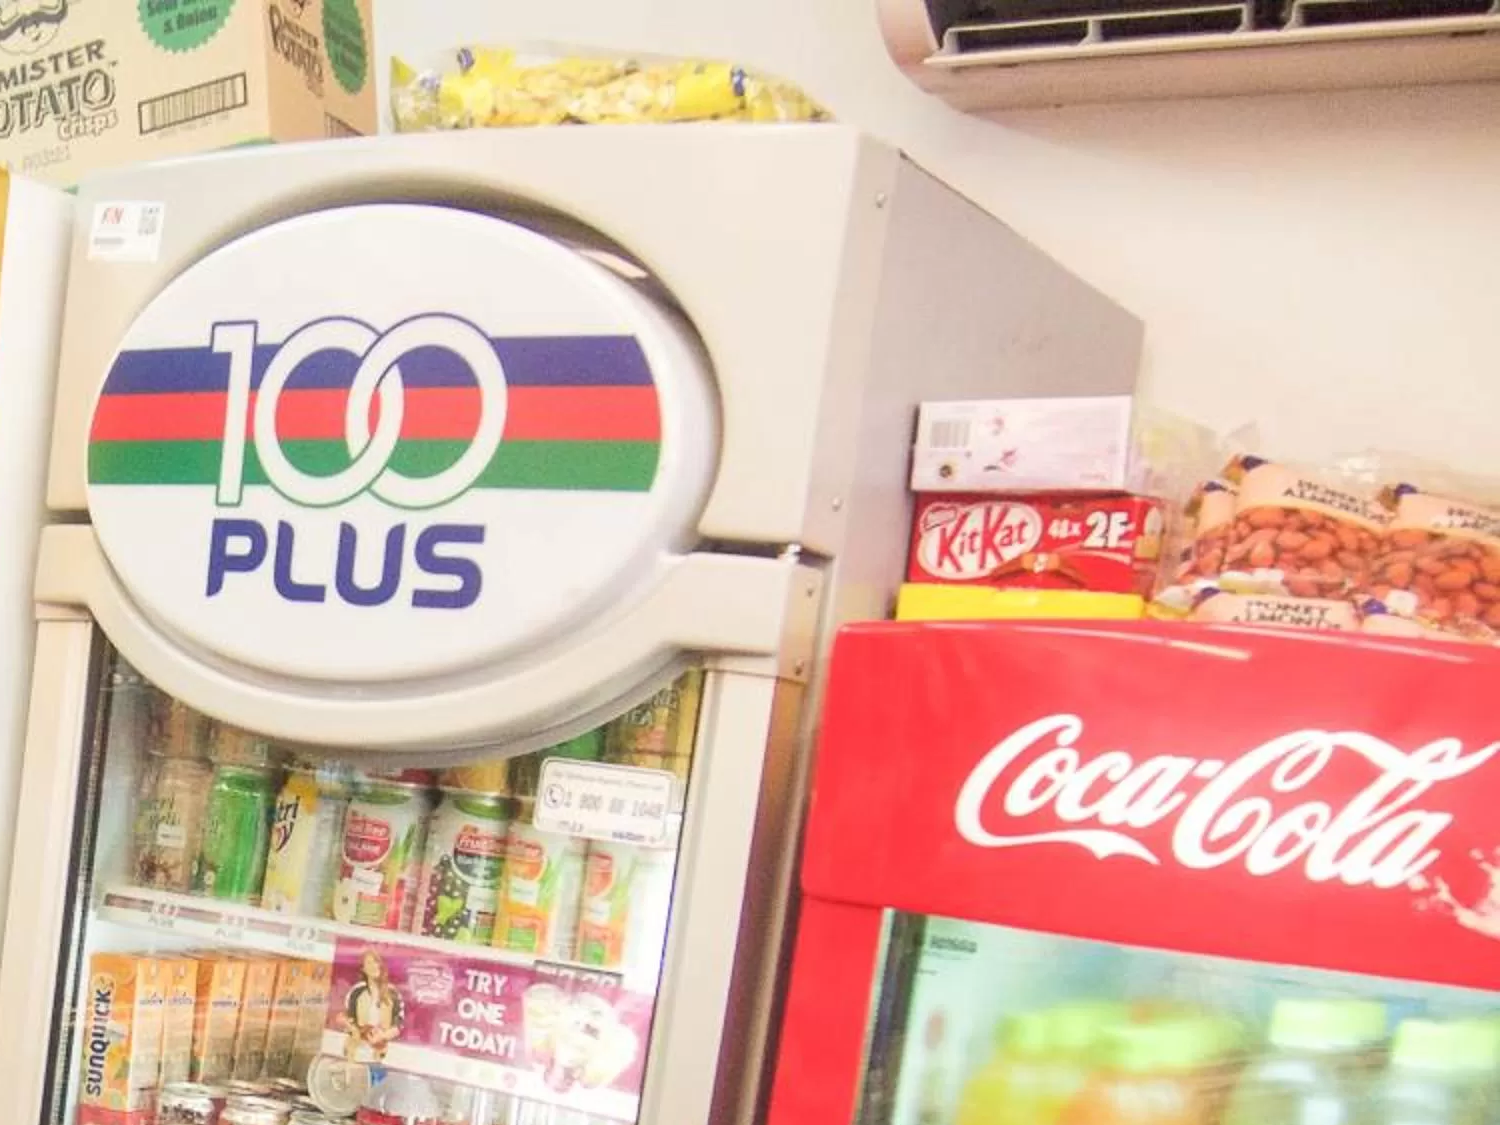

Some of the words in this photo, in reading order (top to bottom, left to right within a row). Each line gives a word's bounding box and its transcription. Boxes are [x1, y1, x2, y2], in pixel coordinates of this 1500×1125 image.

[211, 311, 508, 511] 100
[205, 516, 487, 610] PLUS
[954, 713, 1500, 888] Coca-Cola
[457, 998, 507, 1027] ONE
[464, 968, 508, 998] TRY
[438, 1021, 517, 1060] TODAY!
